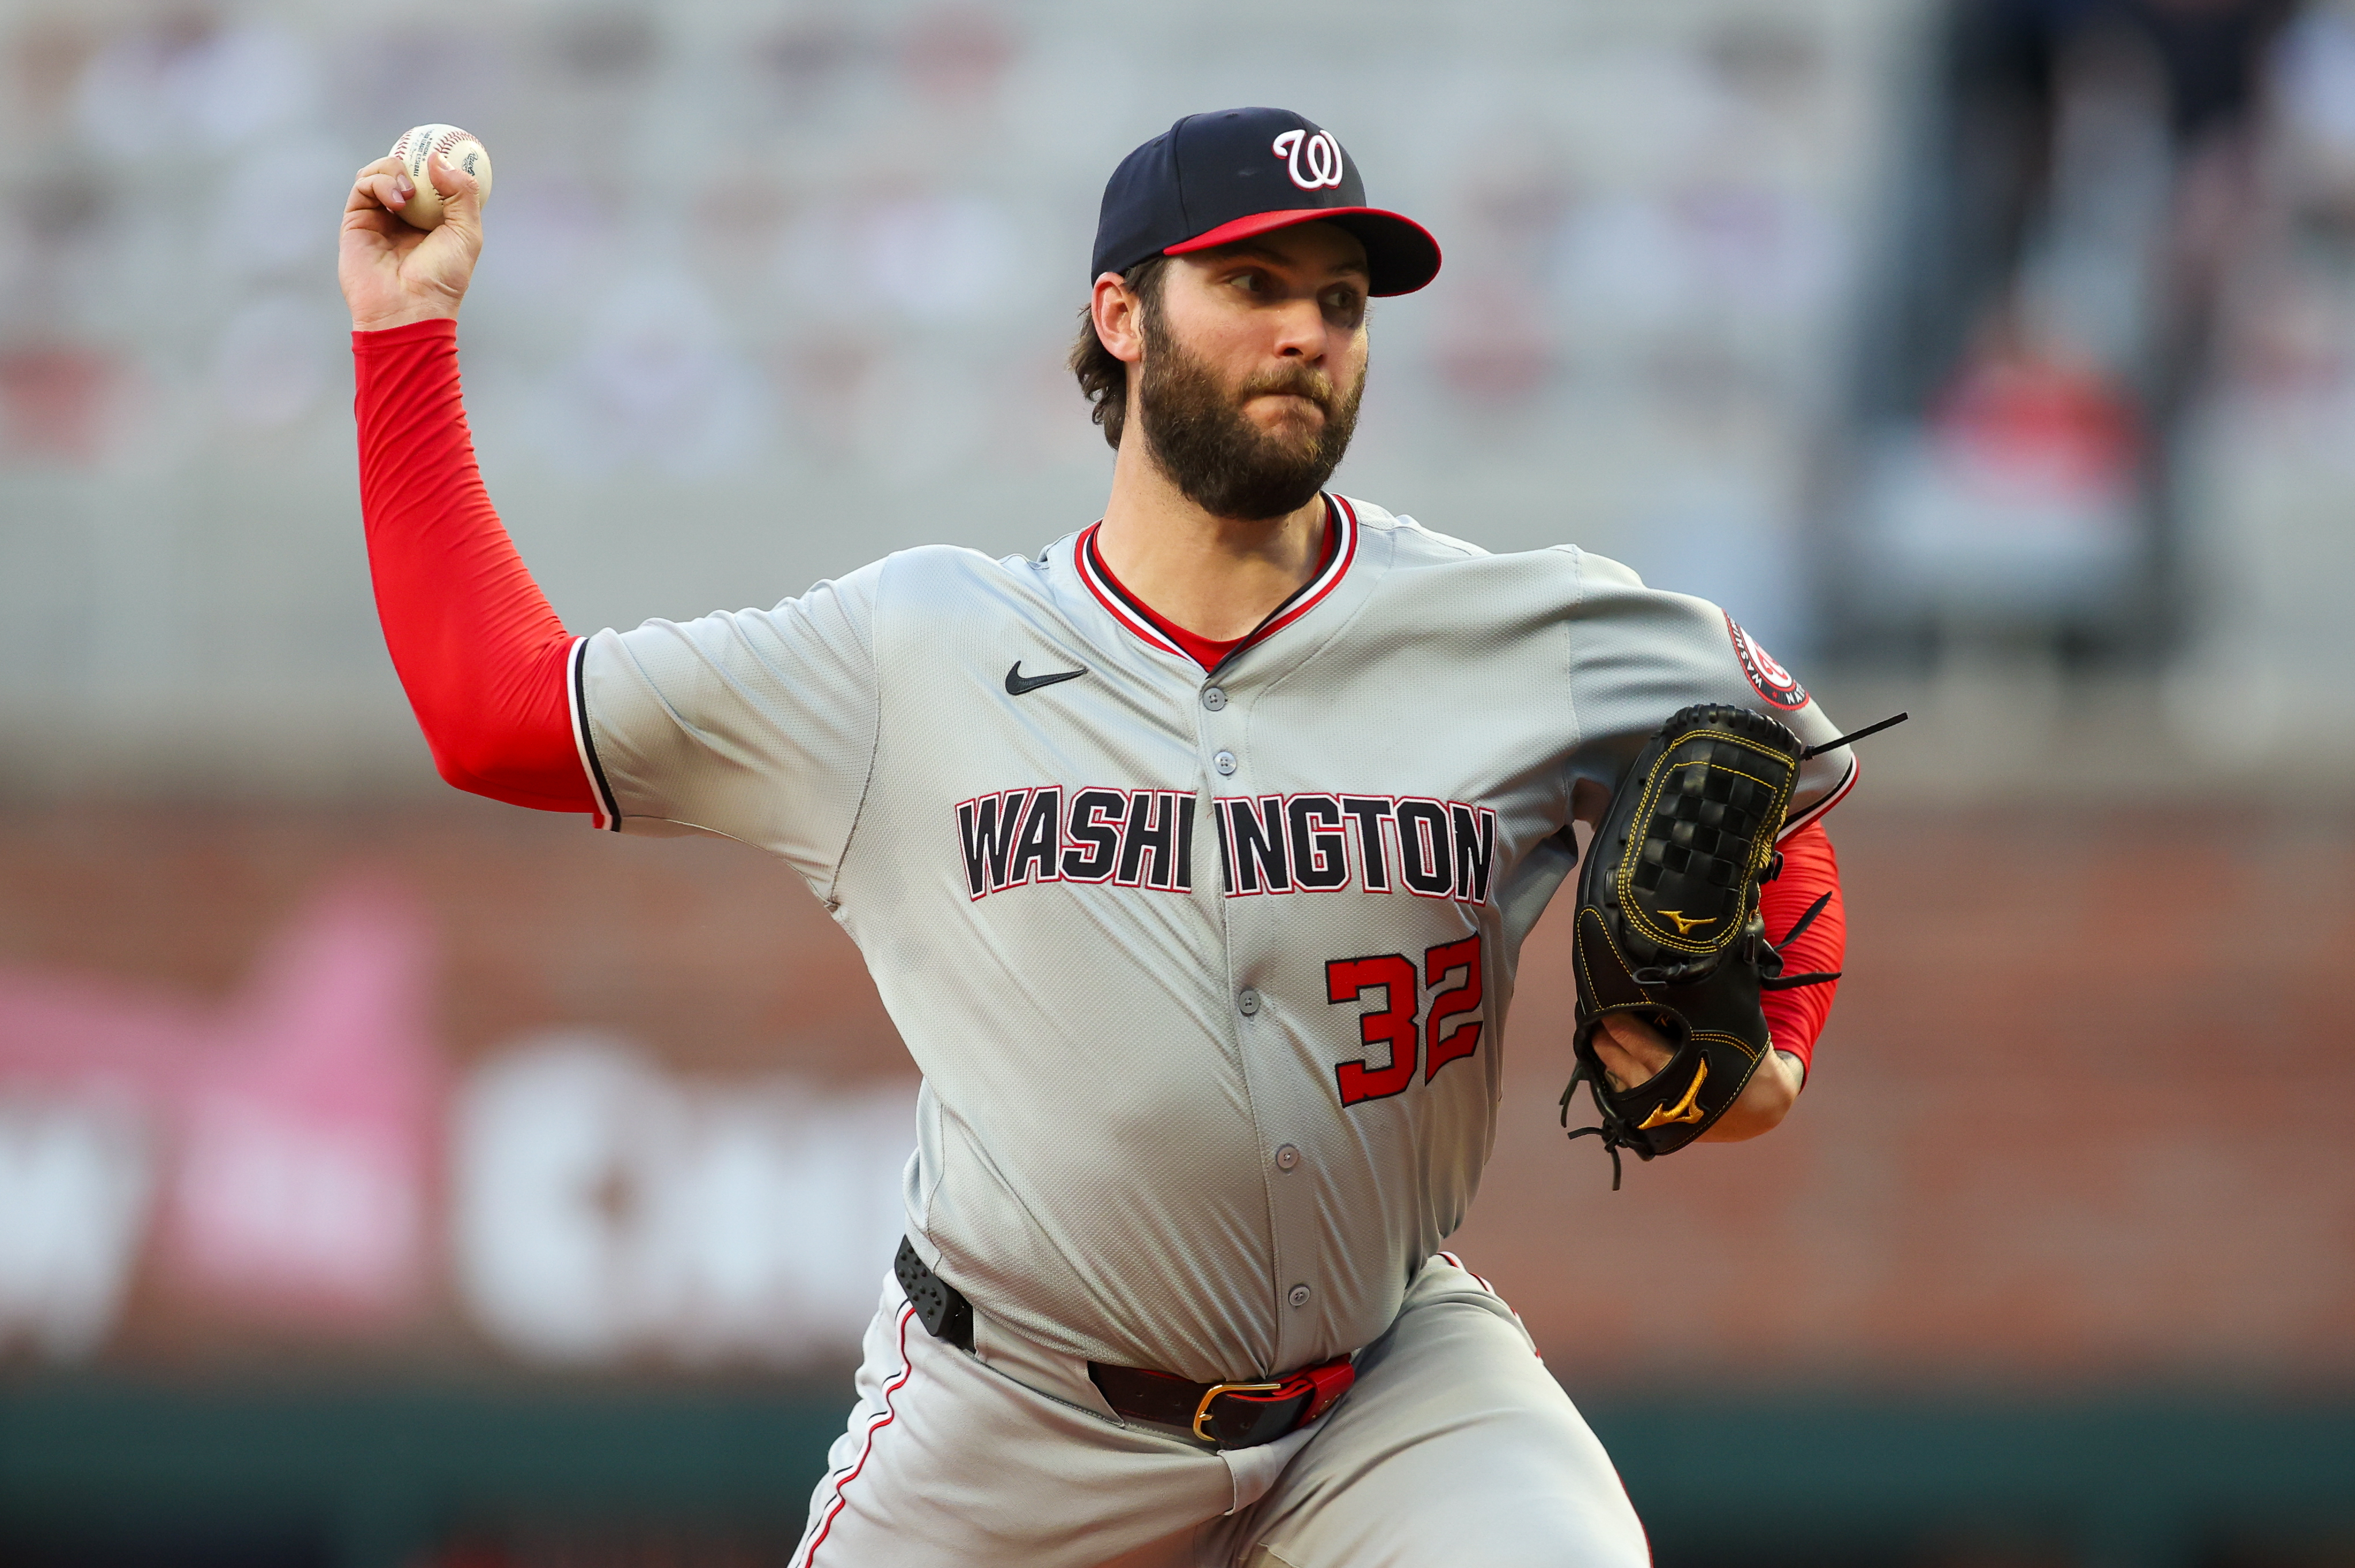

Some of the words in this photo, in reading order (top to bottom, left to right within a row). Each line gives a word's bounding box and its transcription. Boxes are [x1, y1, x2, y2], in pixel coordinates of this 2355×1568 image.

[413, 153, 422, 177] BASEBALL
[418, 139, 427, 153] LEAGUE
[423, 141, 432, 157] OFFICIAL
[1271, 129, 1343, 192] W
[955, 785, 1496, 907] WASHINGTON
[1325, 933, 1484, 1108] 32
